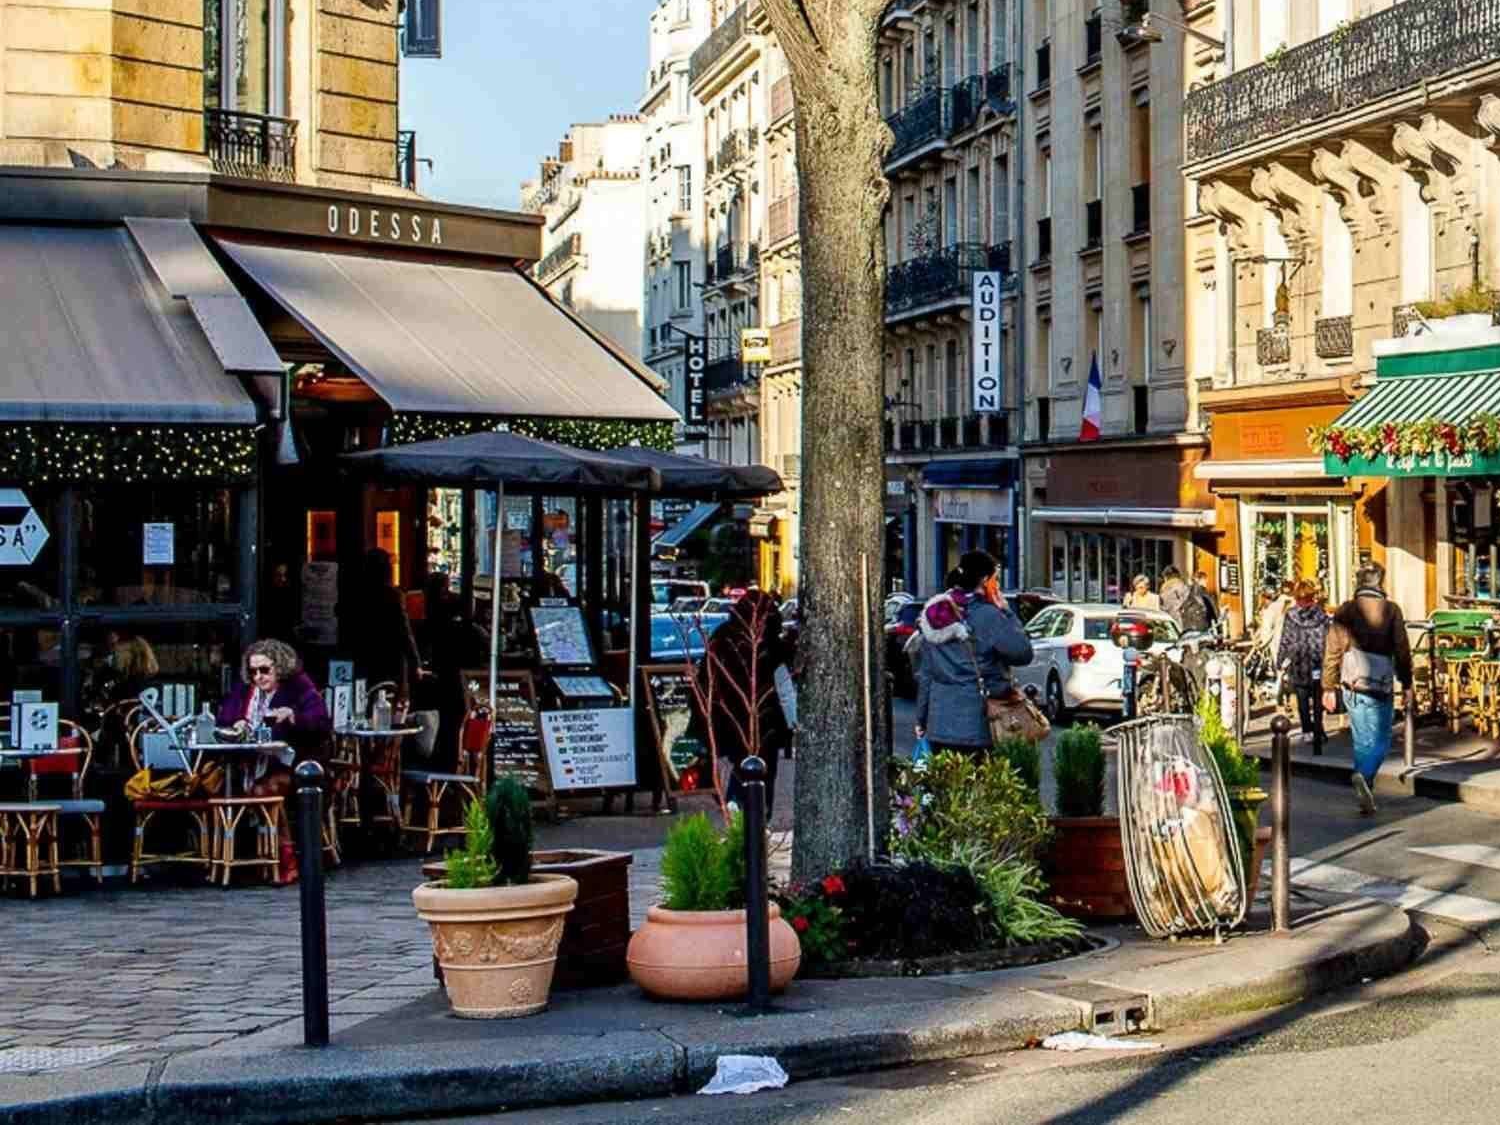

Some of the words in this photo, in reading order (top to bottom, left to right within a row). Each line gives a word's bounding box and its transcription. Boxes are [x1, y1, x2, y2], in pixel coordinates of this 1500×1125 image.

[327, 204, 442, 244] ODESSA
[689, 339, 705, 420] HOTEL
[978, 275, 997, 407] AUDITION
